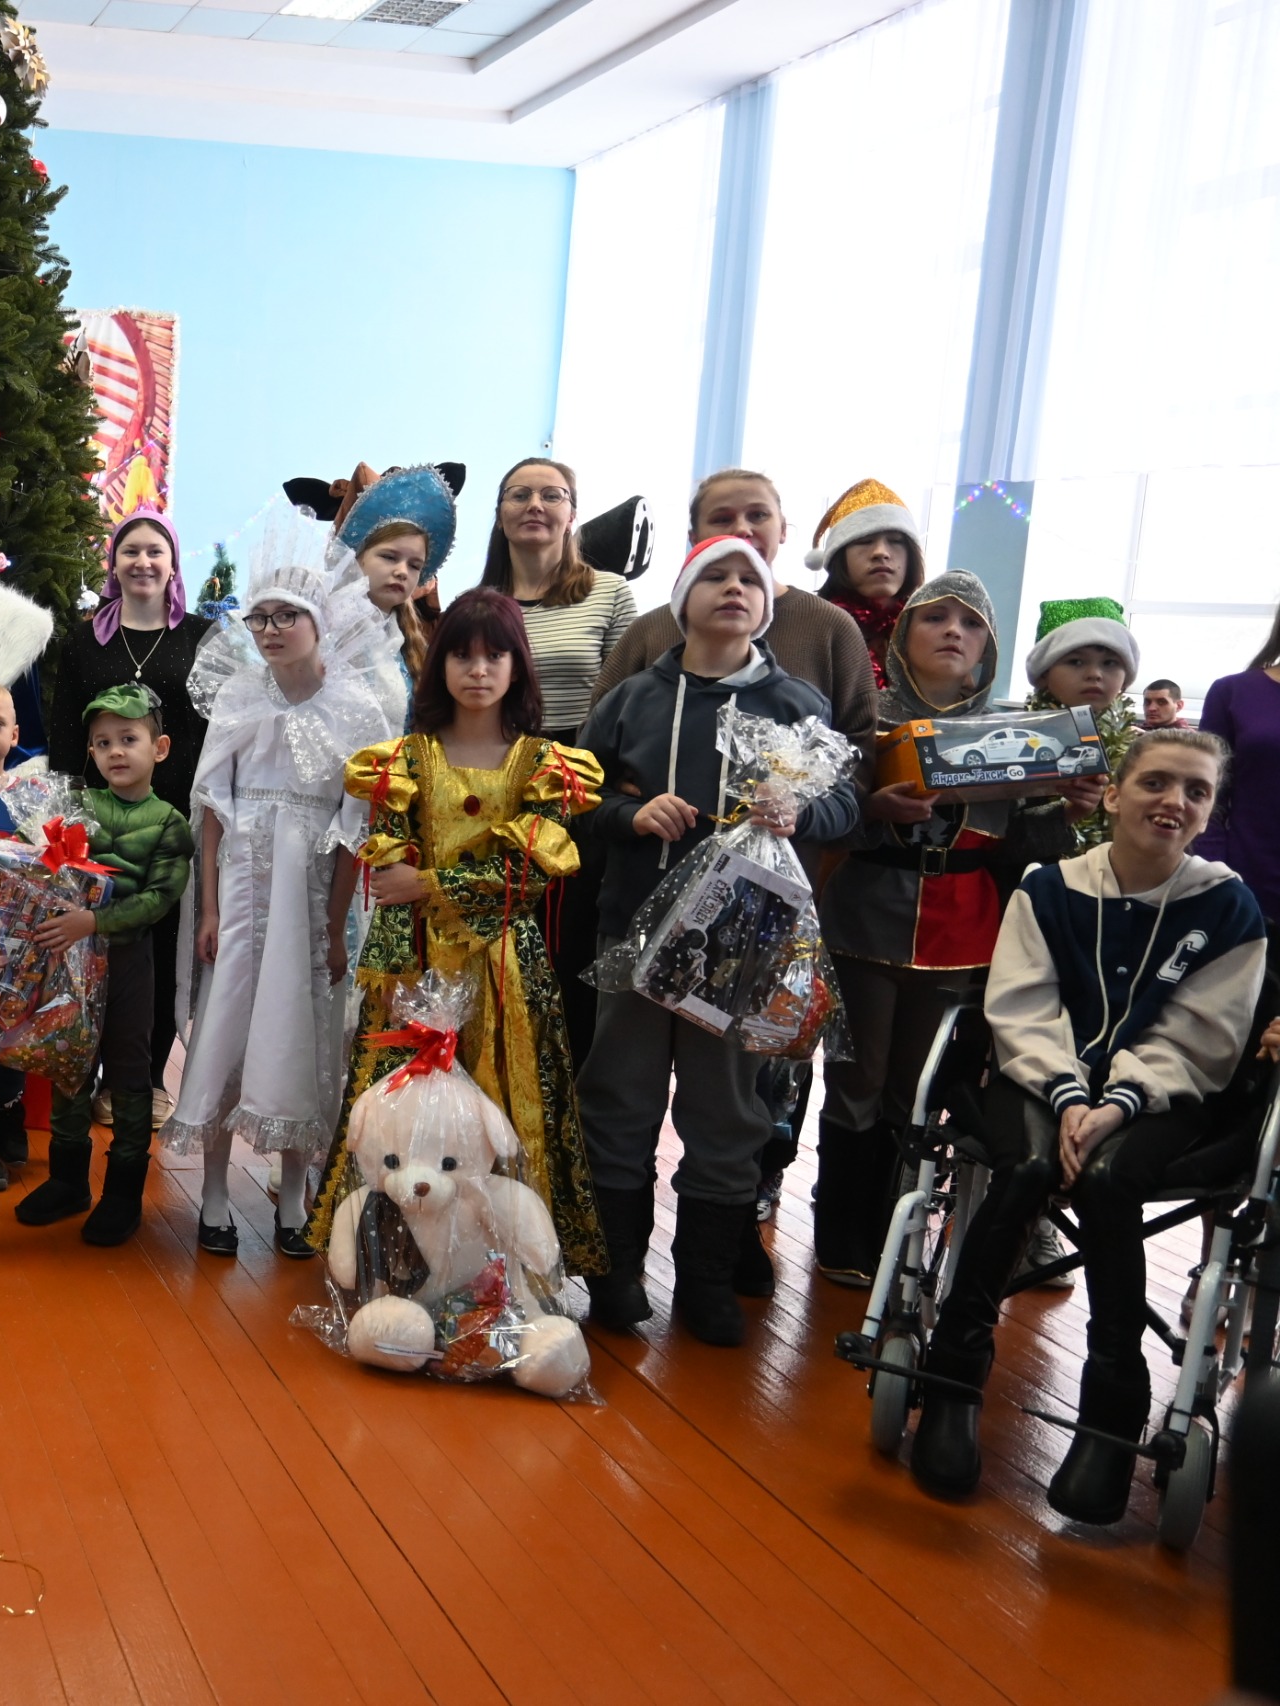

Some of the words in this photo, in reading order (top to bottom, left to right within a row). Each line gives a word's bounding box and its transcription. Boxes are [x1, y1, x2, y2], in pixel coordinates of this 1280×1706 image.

[931, 771, 970, 786] Яндекс
[971, 768, 1004, 781] Такси
[1009, 768, 1024, 777] Go
[693, 879, 727, 925] EXPLORER
[1156, 929, 1209, 984] C
